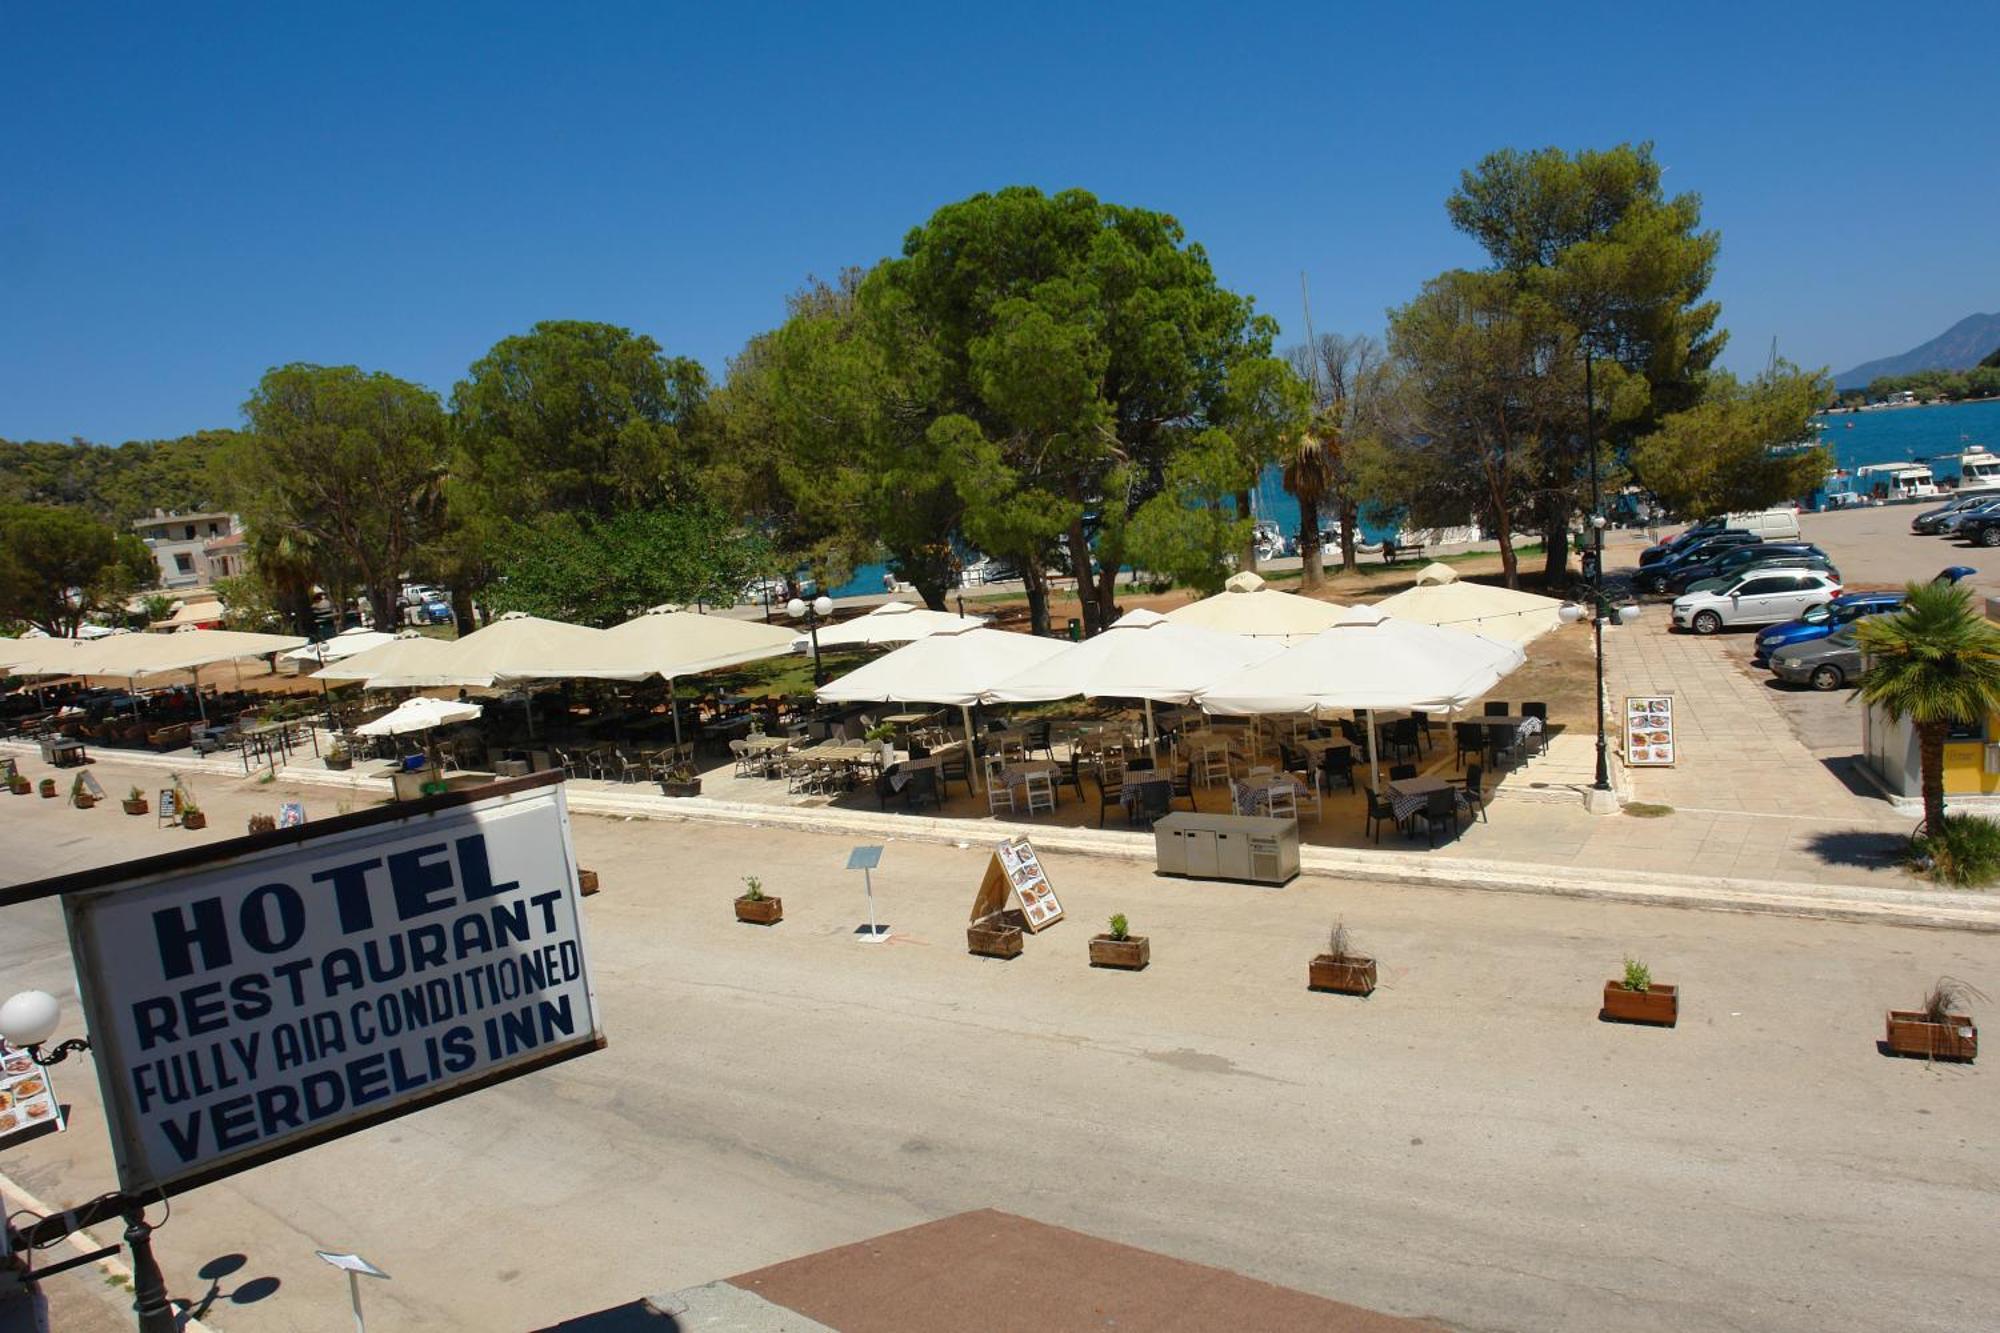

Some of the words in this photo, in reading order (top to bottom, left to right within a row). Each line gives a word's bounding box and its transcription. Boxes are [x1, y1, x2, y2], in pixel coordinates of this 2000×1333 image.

[131, 890, 562, 1050] RESTAURANT
[152, 834, 519, 981] HOTEL
[131, 1032, 259, 1114] FULLY
[271, 1010, 346, 1071] AIR
[350, 940, 580, 1045] CONDITIONED
[160, 1025, 476, 1163] VERDELIS
[484, 995, 574, 1061] INN
